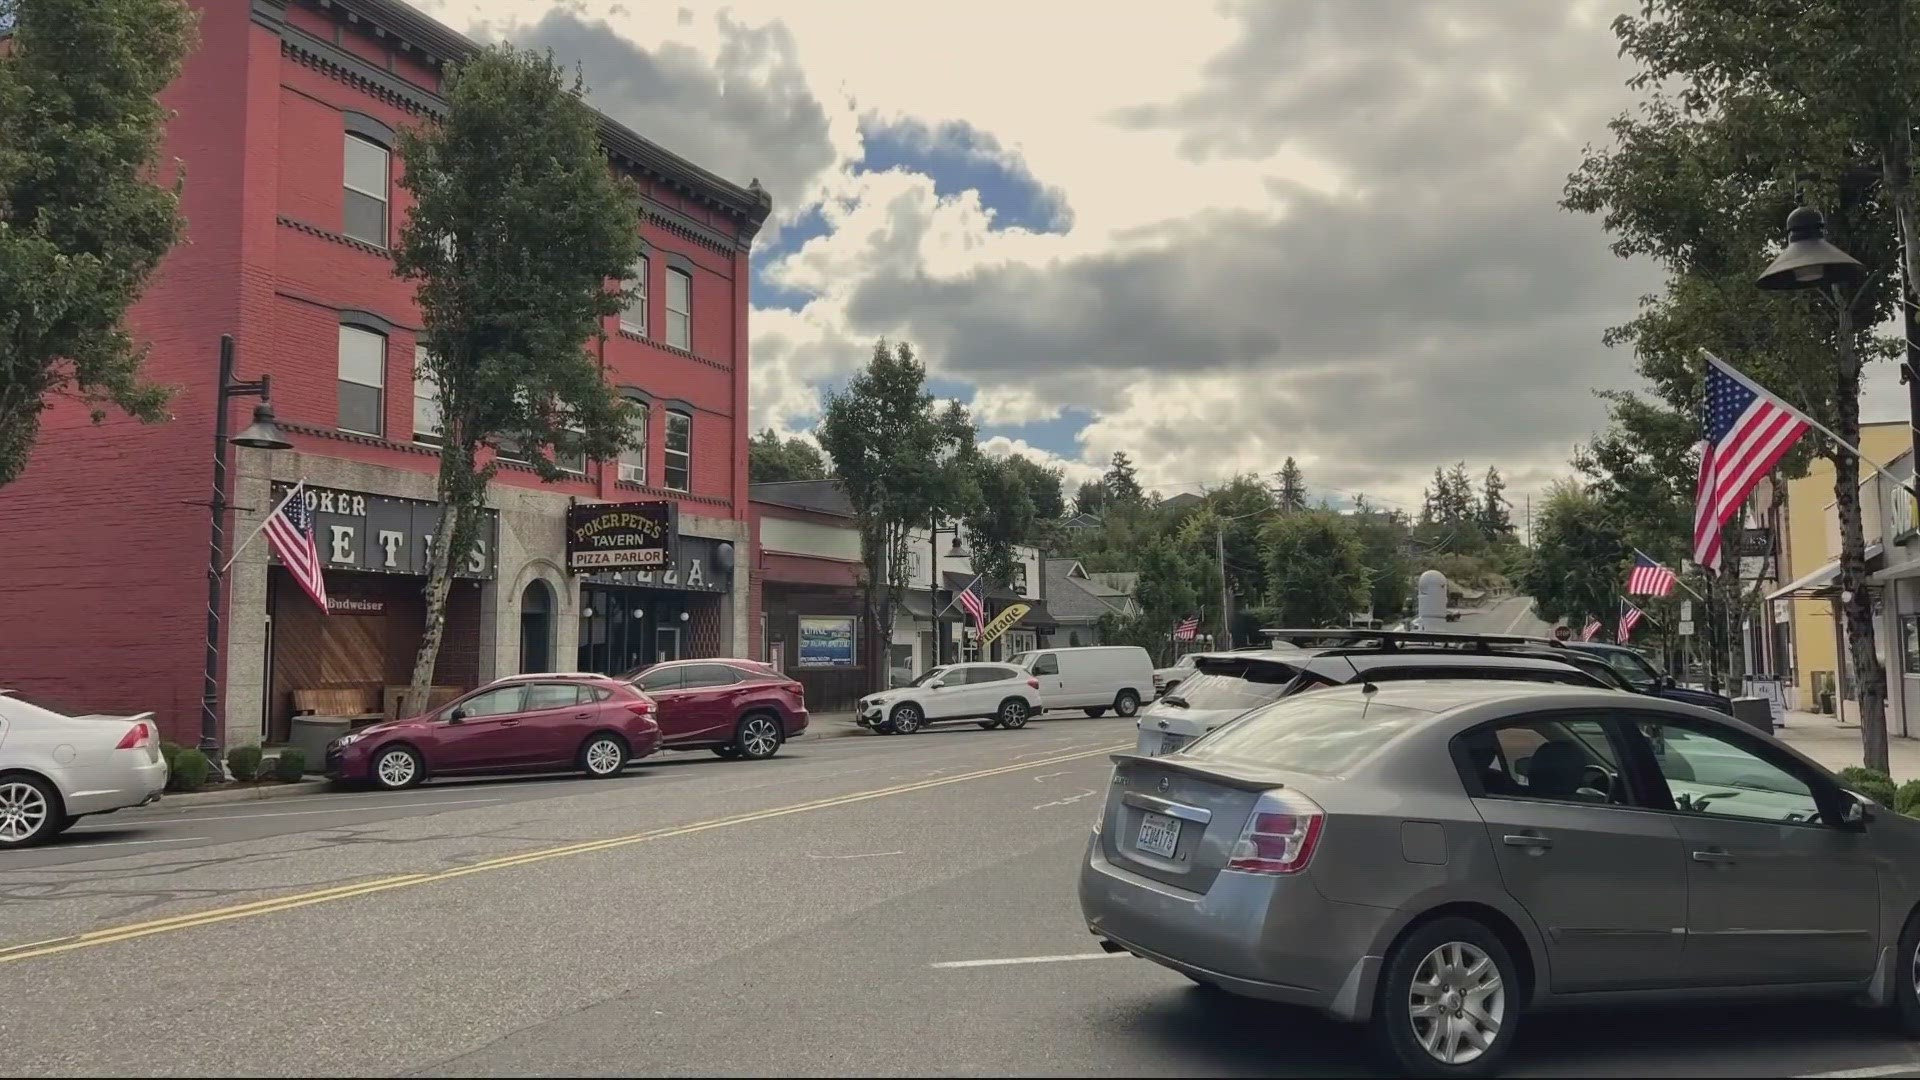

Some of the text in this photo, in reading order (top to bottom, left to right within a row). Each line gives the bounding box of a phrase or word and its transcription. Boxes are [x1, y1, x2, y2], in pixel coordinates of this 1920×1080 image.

[288, 488, 367, 517] OKER
[576, 513, 662, 542] POKER PETE'S
[592, 534, 644, 547] TAVERN
[576, 551, 661, 565] PIZZA PARLOR
[327, 598, 384, 611] Budweiser
[984, 607, 1021, 641] intage
